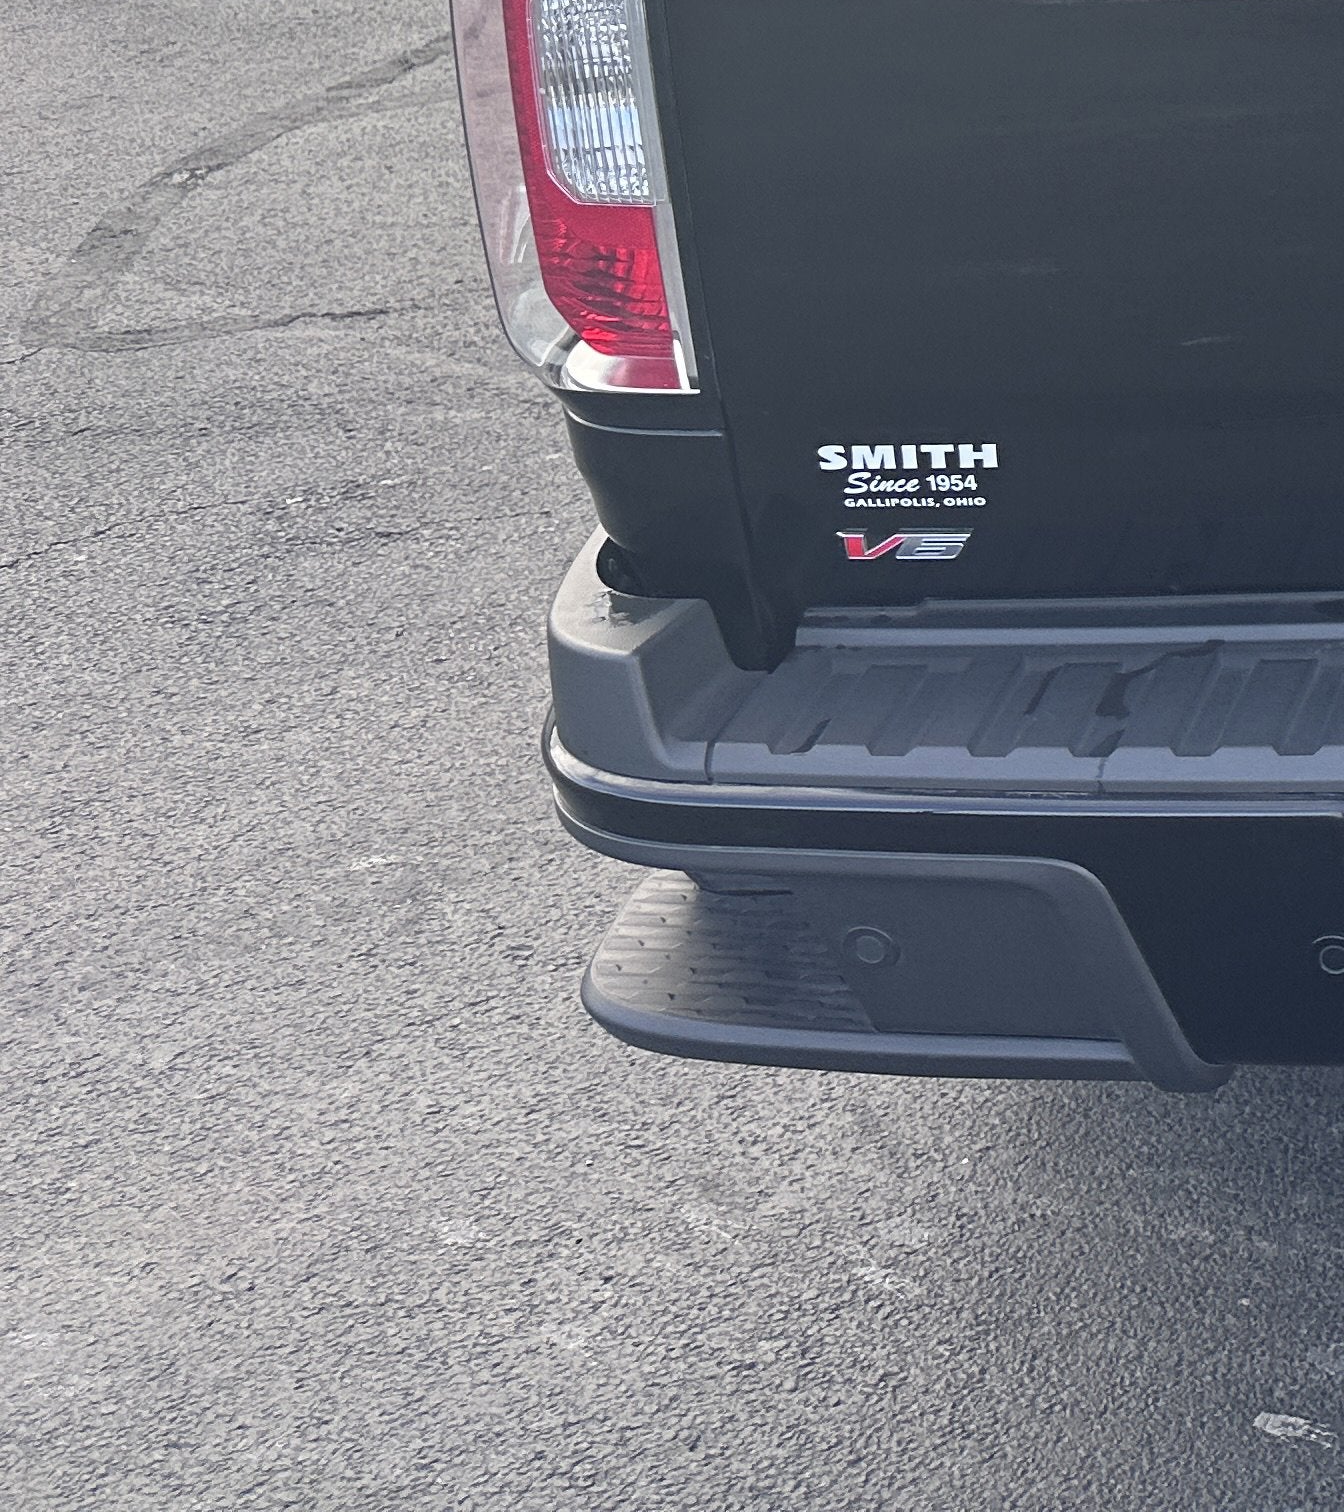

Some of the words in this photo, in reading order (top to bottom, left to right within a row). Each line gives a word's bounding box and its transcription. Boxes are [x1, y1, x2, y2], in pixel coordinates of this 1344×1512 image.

[817, 443, 999, 471] SMITH
[843, 472, 921, 494] Since
[925, 474, 978, 492] 1954
[843, 496, 940, 508] GALLIPOLIS,
[943, 496, 987, 507] OHIO
[836, 527, 974, 560] V6
